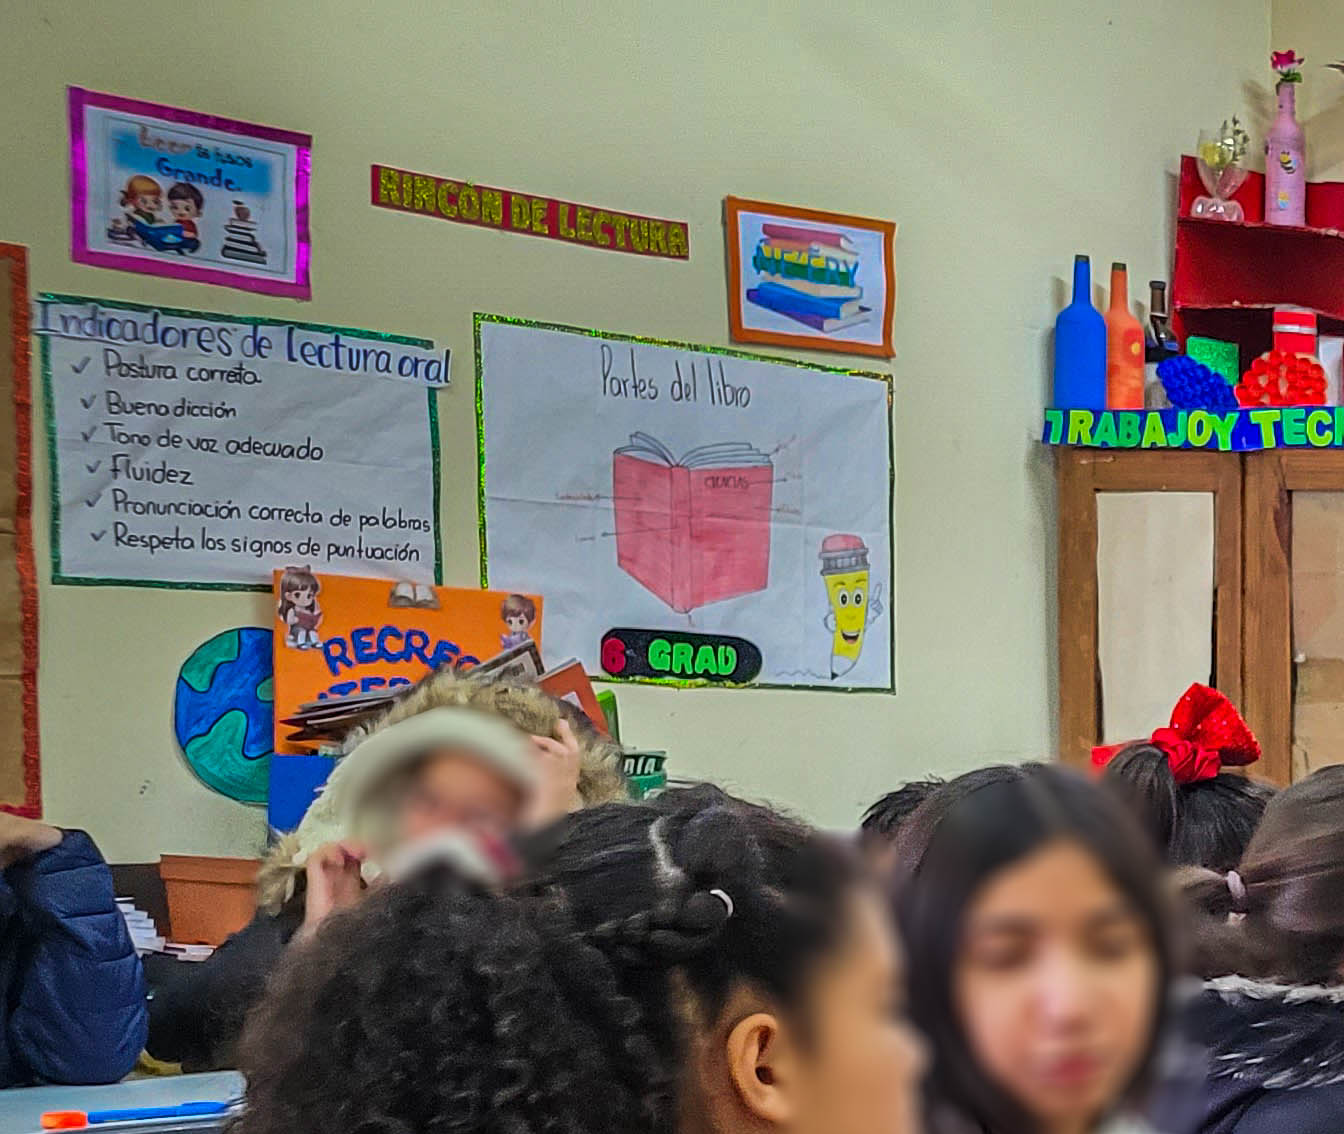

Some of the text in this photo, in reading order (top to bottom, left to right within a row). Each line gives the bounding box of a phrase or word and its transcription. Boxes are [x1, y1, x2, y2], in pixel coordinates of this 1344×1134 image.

[511, 193, 549, 235] DE
[559, 202, 689, 257] LECTURA
[39, 300, 450, 384] Indicadores de lectura oral
[104, 348, 178, 380] Postura
[600, 343, 751, 409] Partes del libro
[173, 397, 238, 419] dicción
[103, 422, 324, 461] Tono de voz adecuado
[109, 453, 194, 486] Fluidez
[111, 488, 432, 533] Pronunciación correcta de palabras
[113, 521, 420, 563] Respeta los signos de puntuación
[601, 636, 738, 676] 6 GRAD
